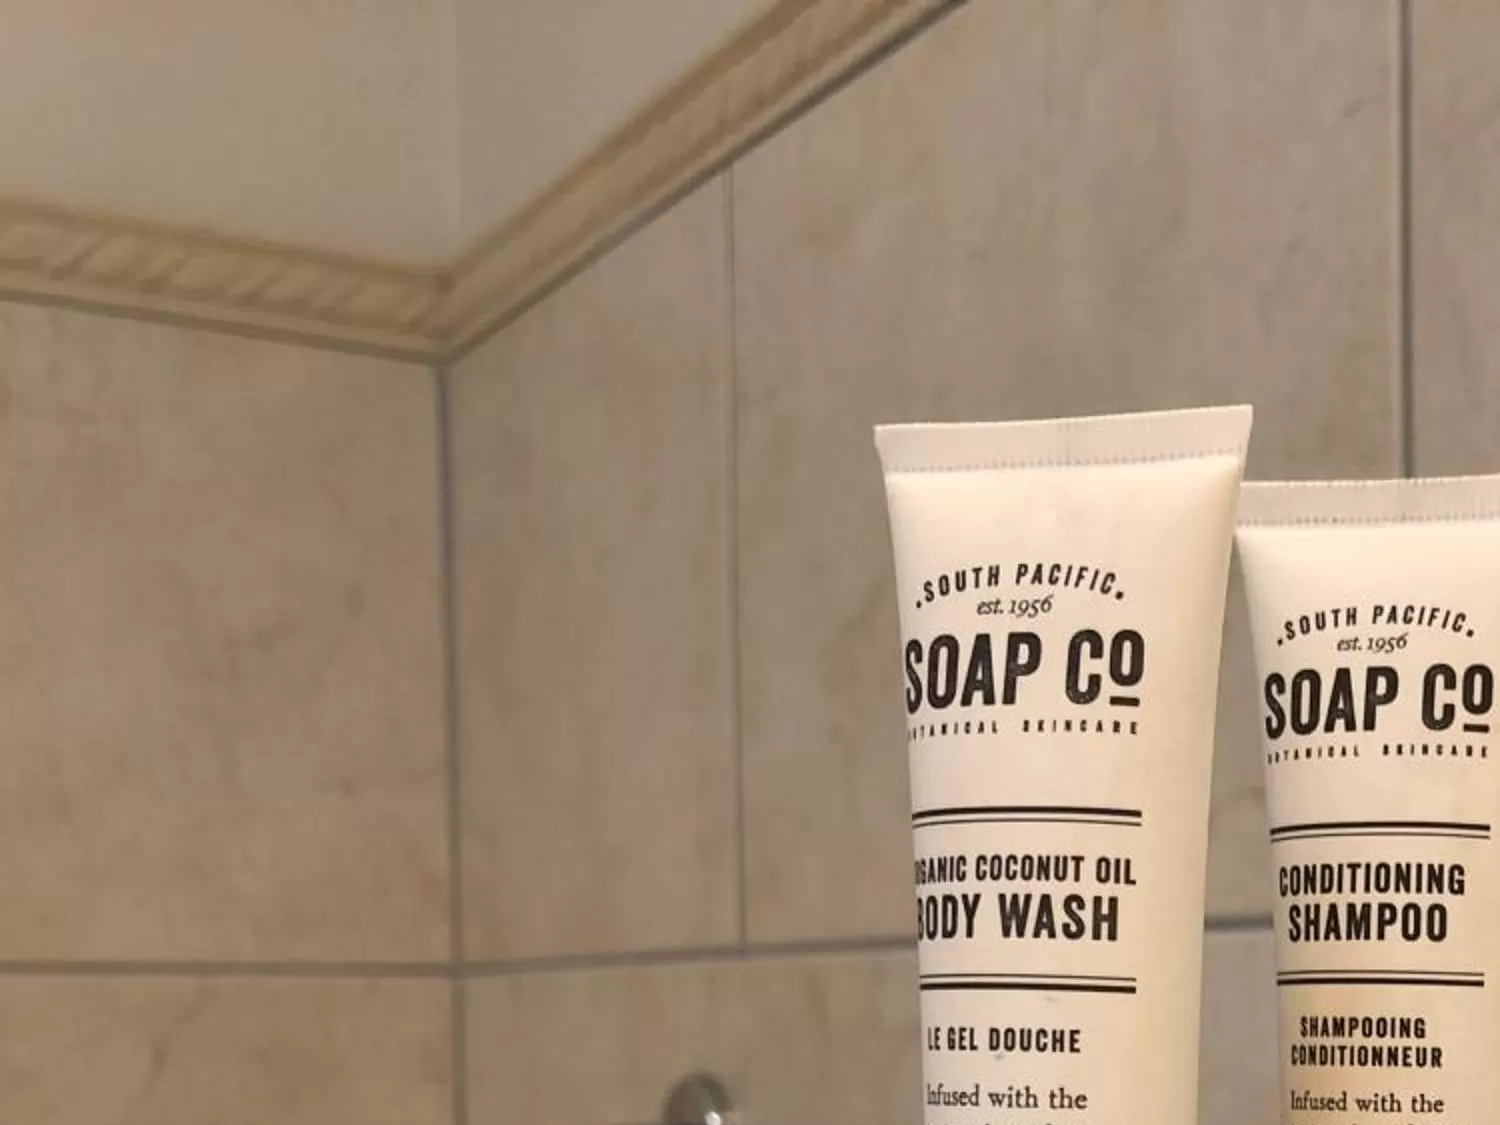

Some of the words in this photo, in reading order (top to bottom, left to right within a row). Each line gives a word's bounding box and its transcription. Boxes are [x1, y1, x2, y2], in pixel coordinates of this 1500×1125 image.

[924, 565, 1000, 602] SOUTH
[1015, 563, 1116, 594] PACIFIC
[977, 600, 1004, 615] est.
[1010, 594, 1054, 617] 1956
[1284, 606, 1357, 639] SOUTH
[1372, 605, 1467, 633] PACIFIC
[1337, 637, 1362, 651] est.
[1368, 632, 1409, 654] 1956
[906, 631, 1042, 714] SOAP
[1264, 665, 1399, 740] SOAP
[1023, 720, 1138, 735] SKINCARE
[976, 854, 1085, 882] COCONUT
[1095, 857, 1137, 885] OIL
[1279, 862, 1465, 898] CONDITIONING
[998, 893, 1119, 941] WASH
[1289, 902, 1448, 942] SHAMPOO
[928, 1027, 941, 1051] LE
[948, 1027, 979, 1051] GEL
[988, 1028, 1081, 1053] DOUCHE
[1300, 1016, 1426, 1039] SHAMPOOING
[1291, 1045, 1443, 1068] CONDITIONNEUR
[927, 1083, 980, 1107] Infused
[989, 1085, 1039, 1108] with
[1049, 1087, 1088, 1109] the
[1290, 1091, 1347, 1112] Infused
[1356, 1092, 1402, 1113] with
[1411, 1094, 1445, 1114] the
